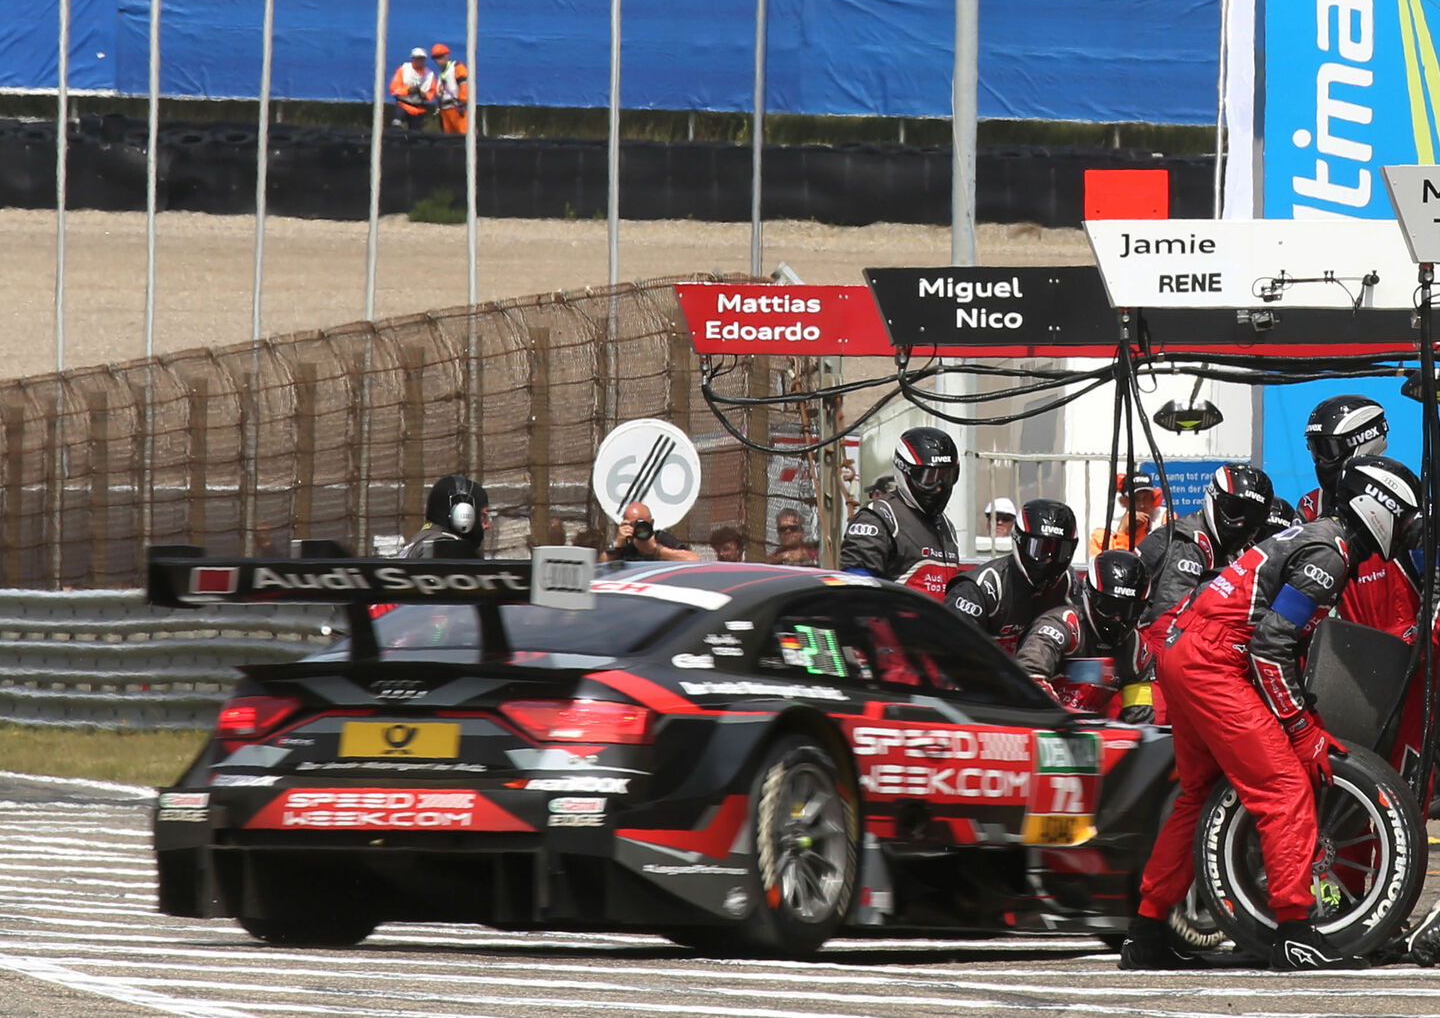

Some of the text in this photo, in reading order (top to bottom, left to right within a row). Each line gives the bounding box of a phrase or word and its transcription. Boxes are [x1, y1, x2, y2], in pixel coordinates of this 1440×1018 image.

[1119, 233, 1216, 257] Jamie
[918, 276, 1023, 303] Miguel
[1158, 272, 1223, 294] RENE
[717, 293, 821, 313] Mattias
[956, 307, 1023, 329] Nico
[705, 320, 821, 341] Edoardo
[1346, 425, 1381, 446] uvex
[931, 455, 952, 463] uvex
[1245, 490, 1266, 504] uvex
[1364, 483, 1404, 517] uvex
[1041, 525, 1064, 536] uvex
[252, 567, 528, 594] Audi Sport
[1114, 586, 1136, 597] uvex
[854, 727, 978, 760] SPEED
[285, 793, 415, 809] SPEED
